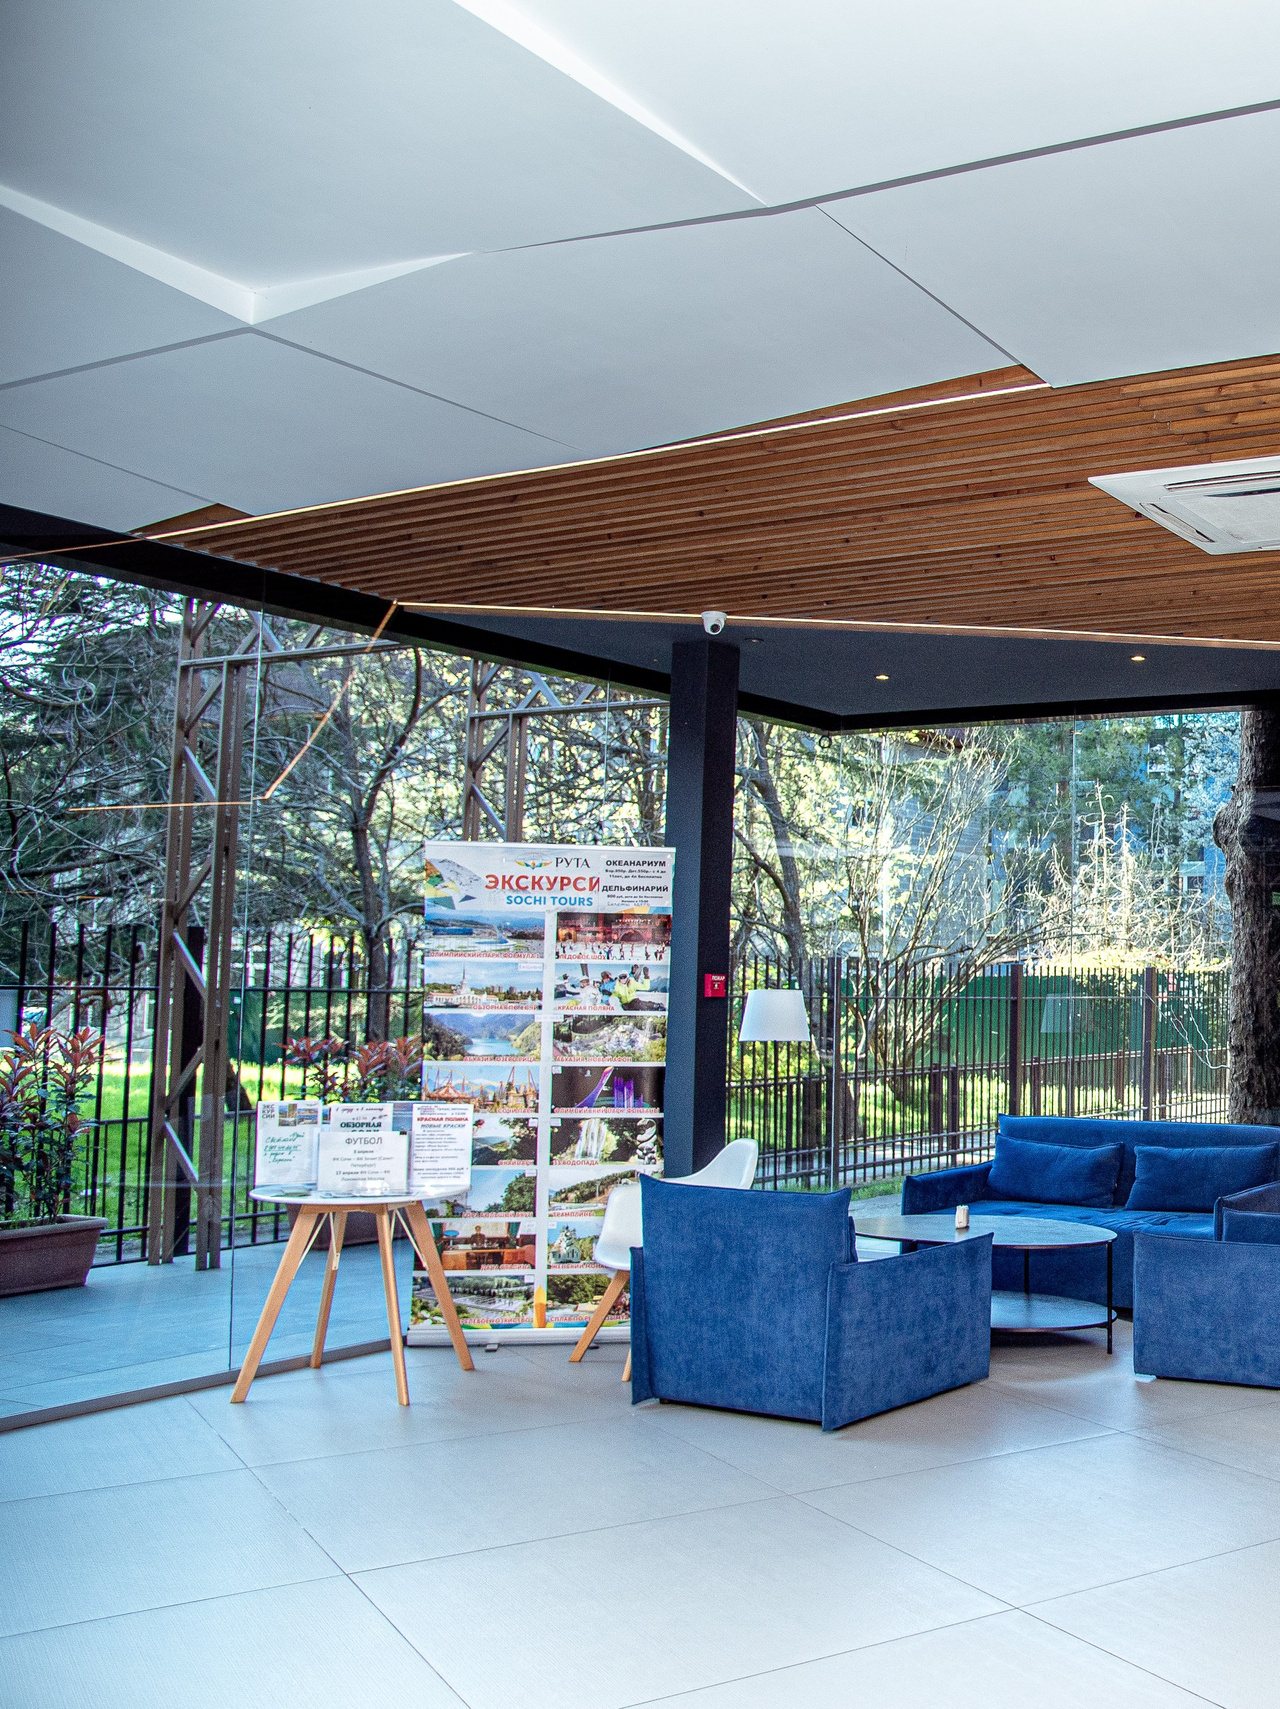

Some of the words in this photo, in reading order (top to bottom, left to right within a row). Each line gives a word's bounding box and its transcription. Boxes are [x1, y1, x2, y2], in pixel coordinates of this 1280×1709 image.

[555, 857, 591, 869] РУТА
[506, 895, 546, 905] SOCHI
[551, 896, 593, 906] TOURS
[340, 1121, 382, 1129] ОБЗОРНАЯ
[345, 1136, 383, 1145] ФУТБОЛ
